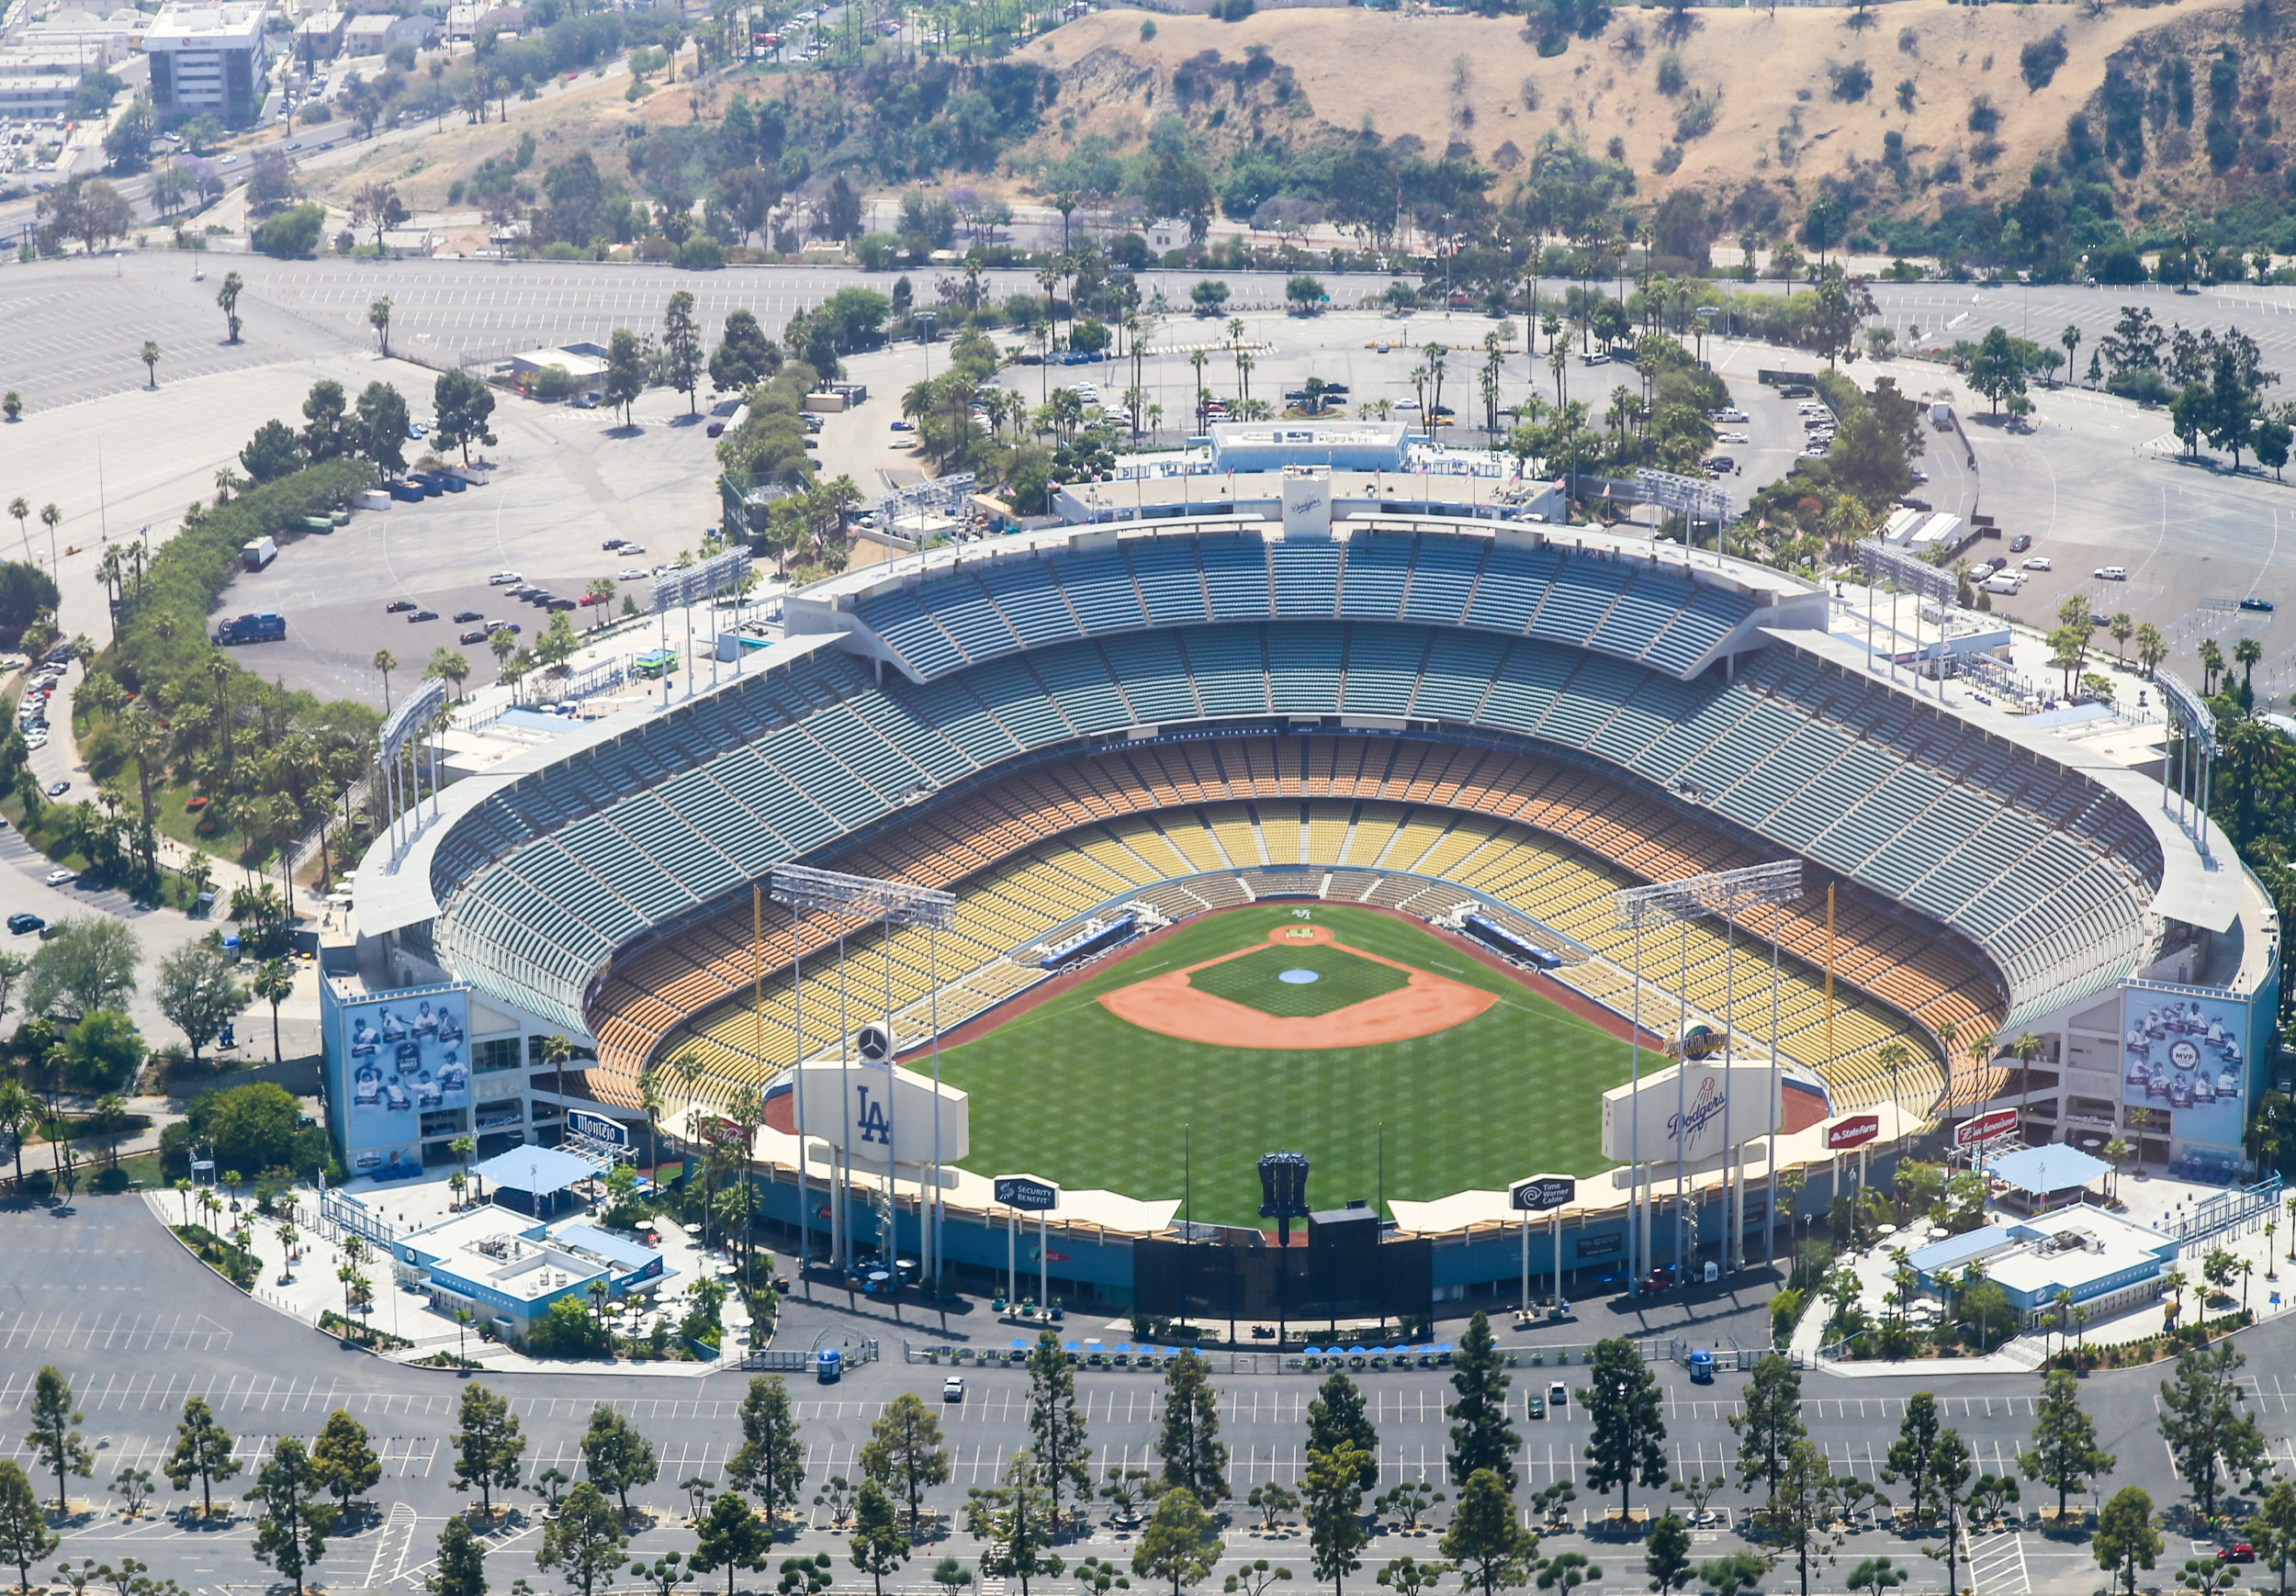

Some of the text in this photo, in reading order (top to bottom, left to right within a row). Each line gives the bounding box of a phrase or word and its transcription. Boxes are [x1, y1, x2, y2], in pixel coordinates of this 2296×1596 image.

[1290, 498, 1322, 514] Dodgers
[1102, 739, 1145, 751] WELCOME
[1173, 731, 1212, 740] DODGER
[1669, 1034, 1705, 1054] UNVERSAL
[2176, 1052, 2193, 1061] MVP
[857, 1085, 890, 1145] LA
[1667, 1092, 1727, 1140] Dodgers
[577, 1114, 615, 1141] Montejo
[1960, 1117, 2016, 1141] Budweiser
[1018, 1186, 1052, 1197] SECURITY
[1018, 1194, 1048, 1204] BENEFIT
[1543, 1188, 1569, 1197] Warner
[1543, 1195, 1563, 1205] Cable
